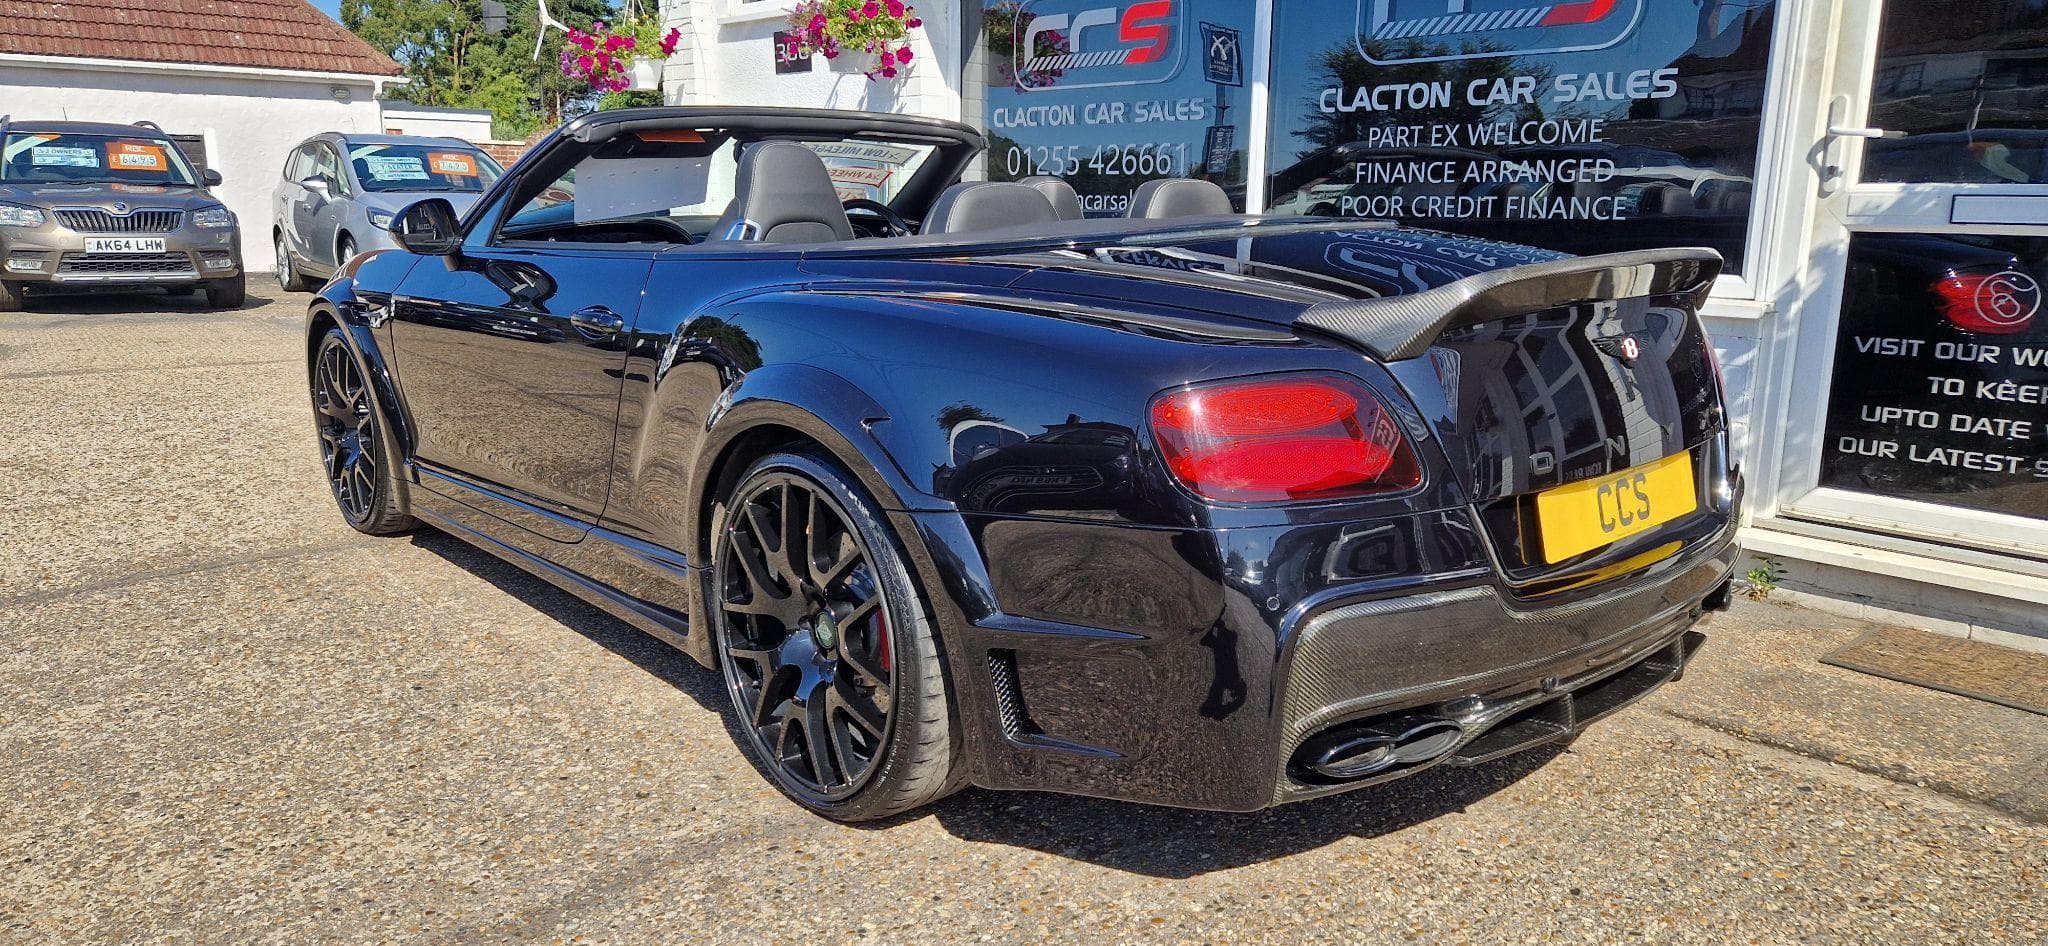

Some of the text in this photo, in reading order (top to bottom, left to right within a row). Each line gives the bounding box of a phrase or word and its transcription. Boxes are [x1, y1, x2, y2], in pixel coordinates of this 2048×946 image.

[1320, 68, 1679, 114] CLACTON CAR SALES
[993, 97, 1205, 128] CLACTON CAR SALES
[1369, 119, 1604, 148] PART EX WELCOME
[1007, 145, 1079, 176] 01255
[1089, 142, 1185, 176] 426661
[1355, 158, 1615, 184] FINANCE ARRANGED
[1341, 195, 1627, 221] POOR CREDIT FINANCE
[95, 240, 163, 251] AK64 LHW
[1854, 336, 1925, 357] VISIT
[1935, 342, 2000, 364] OUR
[1928, 376, 1964, 396] TO
[1860, 404, 1940, 429] UPTO
[1949, 414, 2032, 440] DATE
[1838, 436, 1900, 459] OUR
[1909, 444, 2025, 475] LATEST
[1596, 473, 1651, 533] CCS
